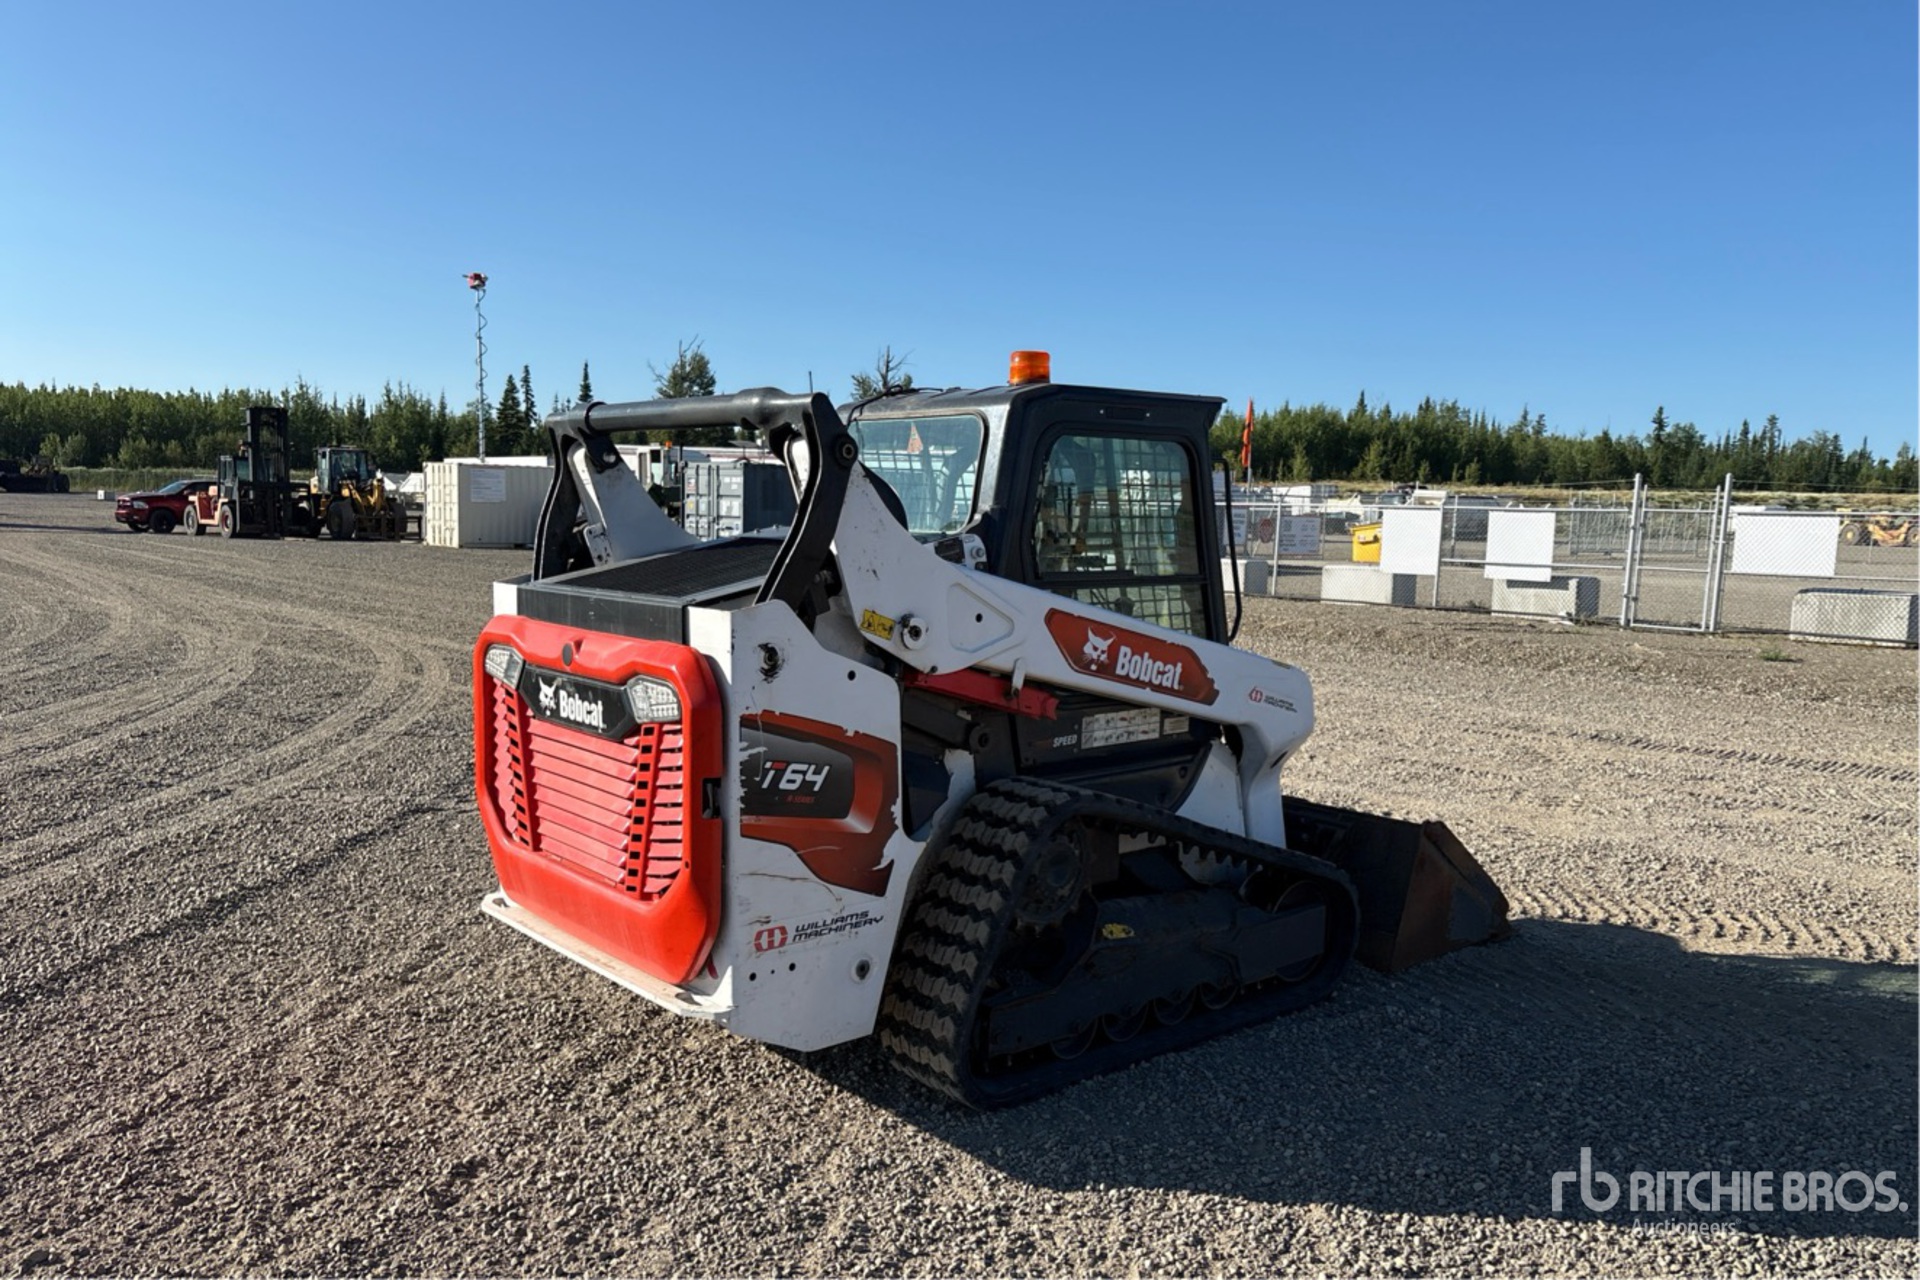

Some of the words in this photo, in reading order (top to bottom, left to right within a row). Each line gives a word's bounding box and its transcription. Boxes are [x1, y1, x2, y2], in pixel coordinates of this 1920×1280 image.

[1115, 645, 1184, 690] Bobcat
[559, 689, 604, 728] Bobcat
[1053, 734, 1078, 748] SPEED
[761, 761, 831, 792] T64
[792, 915, 884, 943] MACHINERY
[795, 910, 869, 933] WILLIAMS
